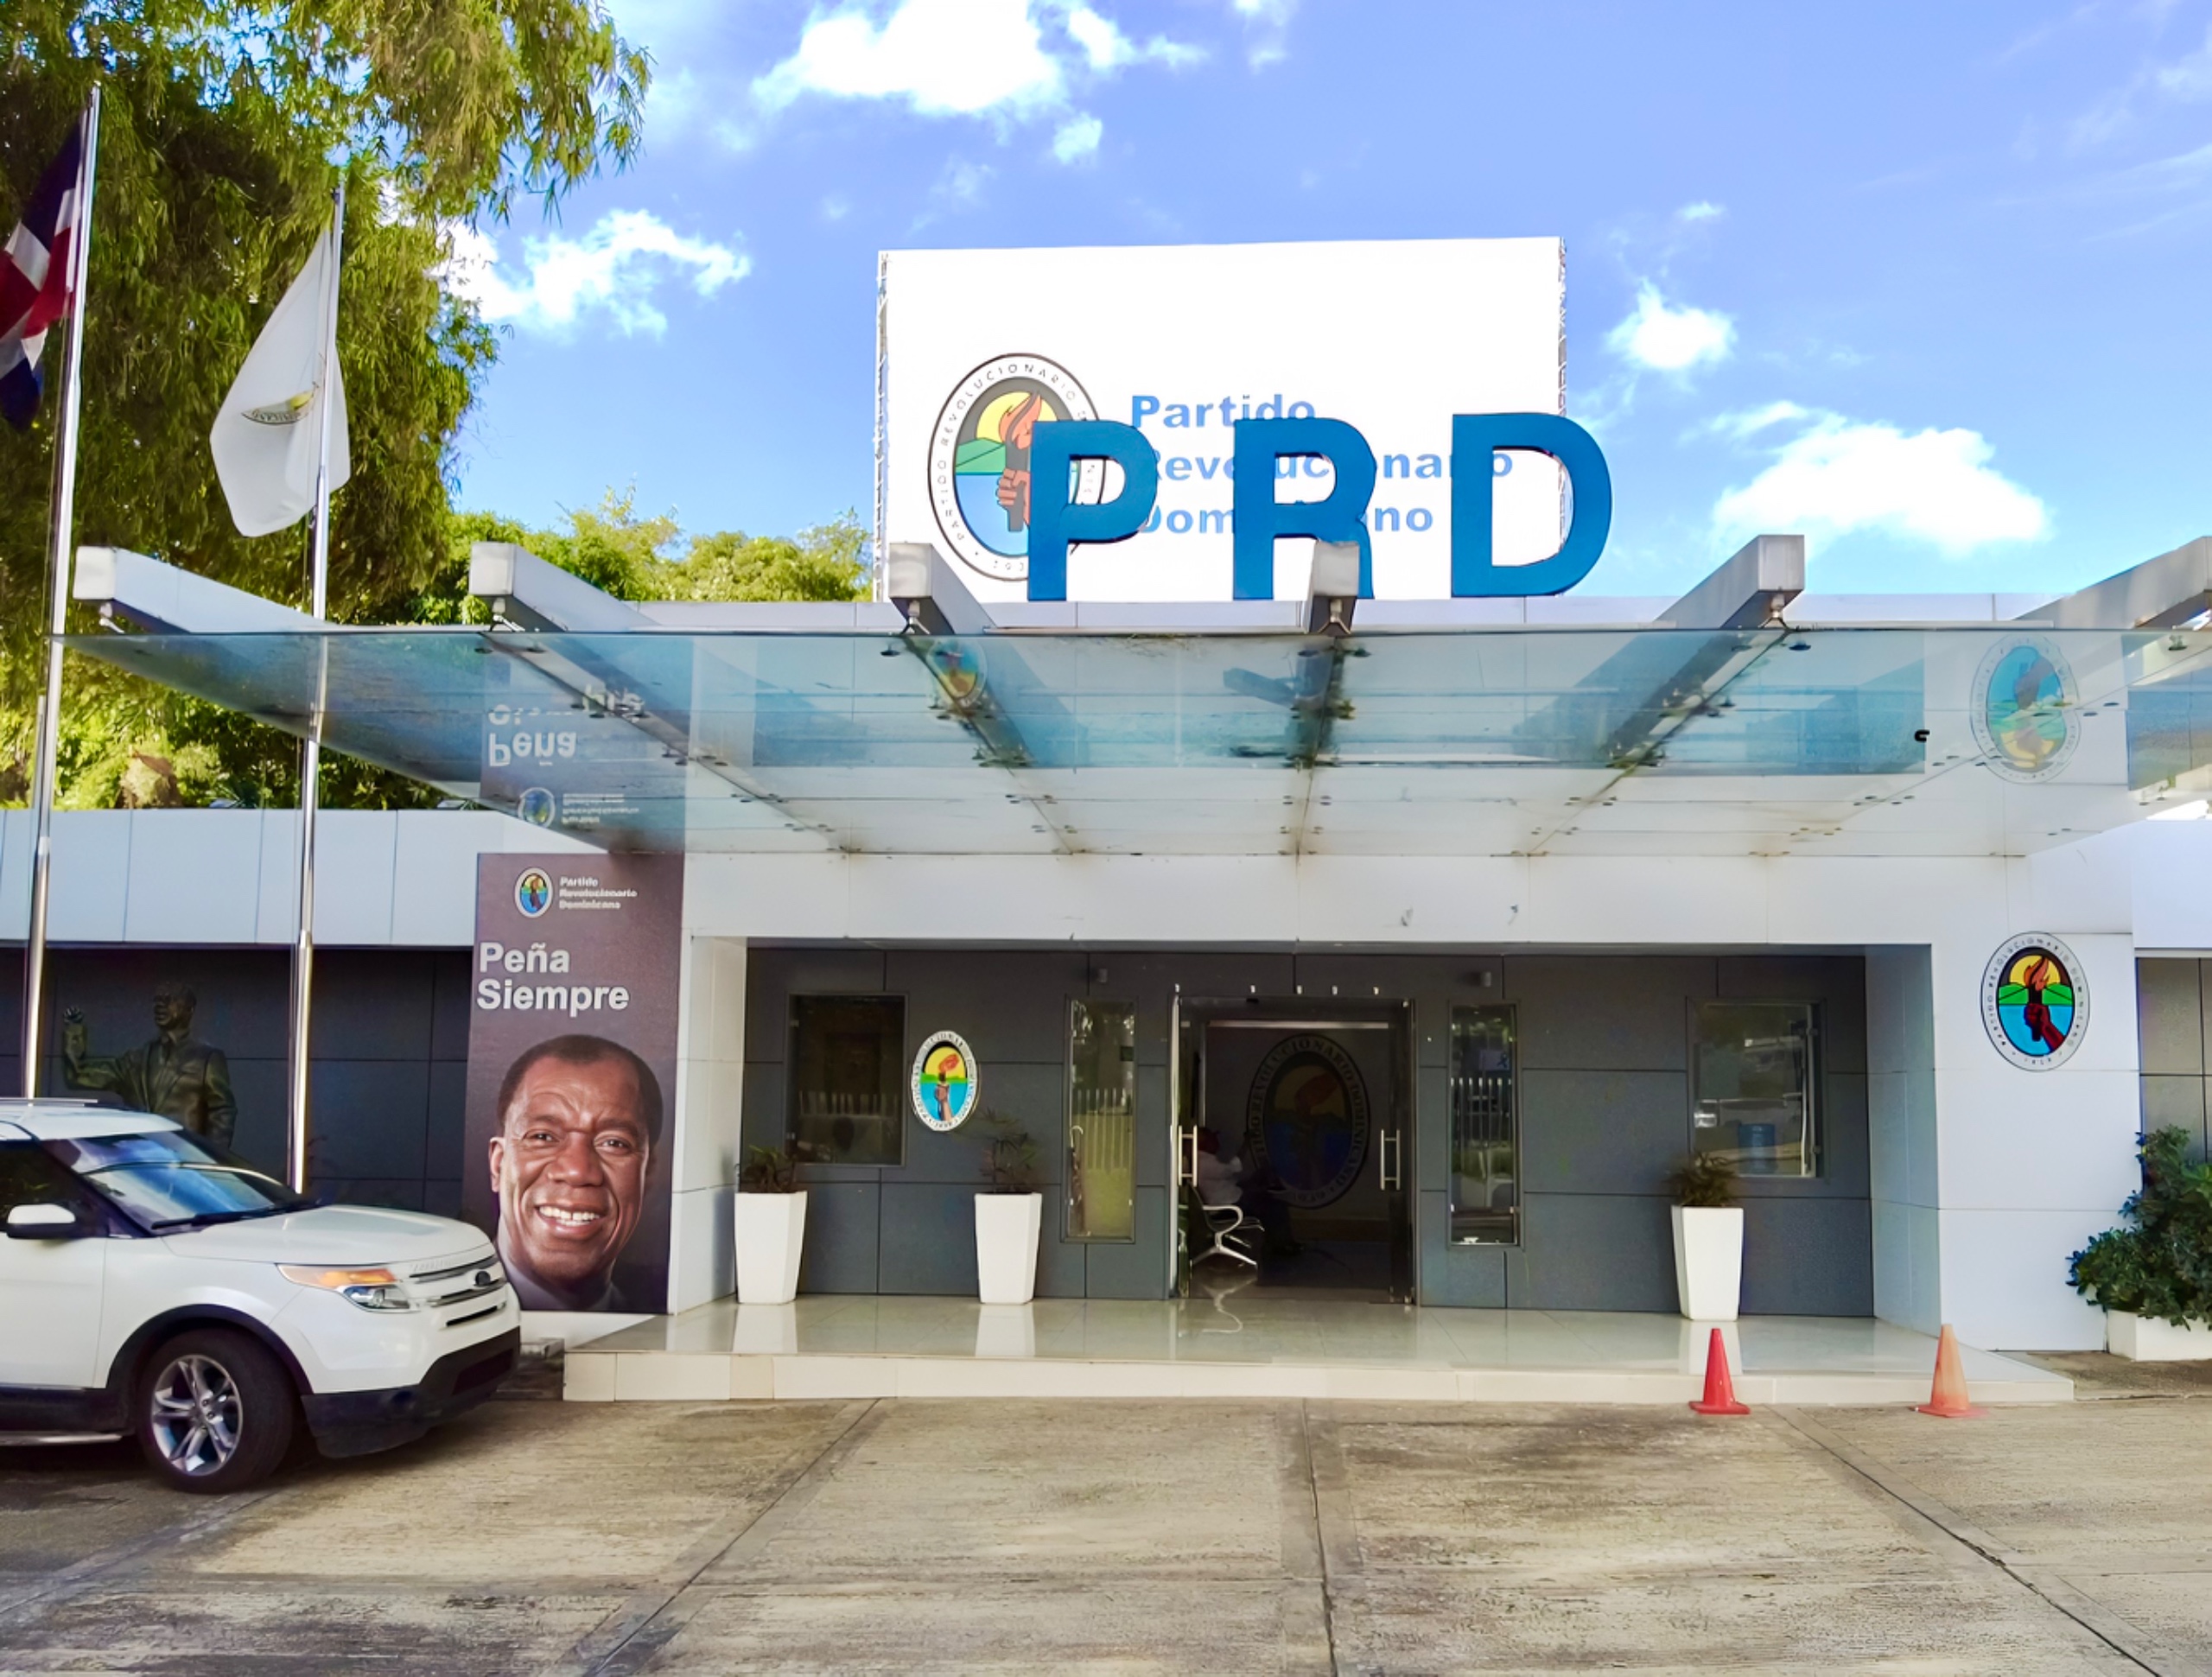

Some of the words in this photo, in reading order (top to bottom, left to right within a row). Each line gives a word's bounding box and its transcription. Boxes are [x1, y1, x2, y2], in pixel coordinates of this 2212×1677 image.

[1132, 394, 1314, 428] Partido
[1028, 412, 1612, 601] PRD
[480, 942, 570, 973] Peña
[477, 978, 630, 1018] Siempre
